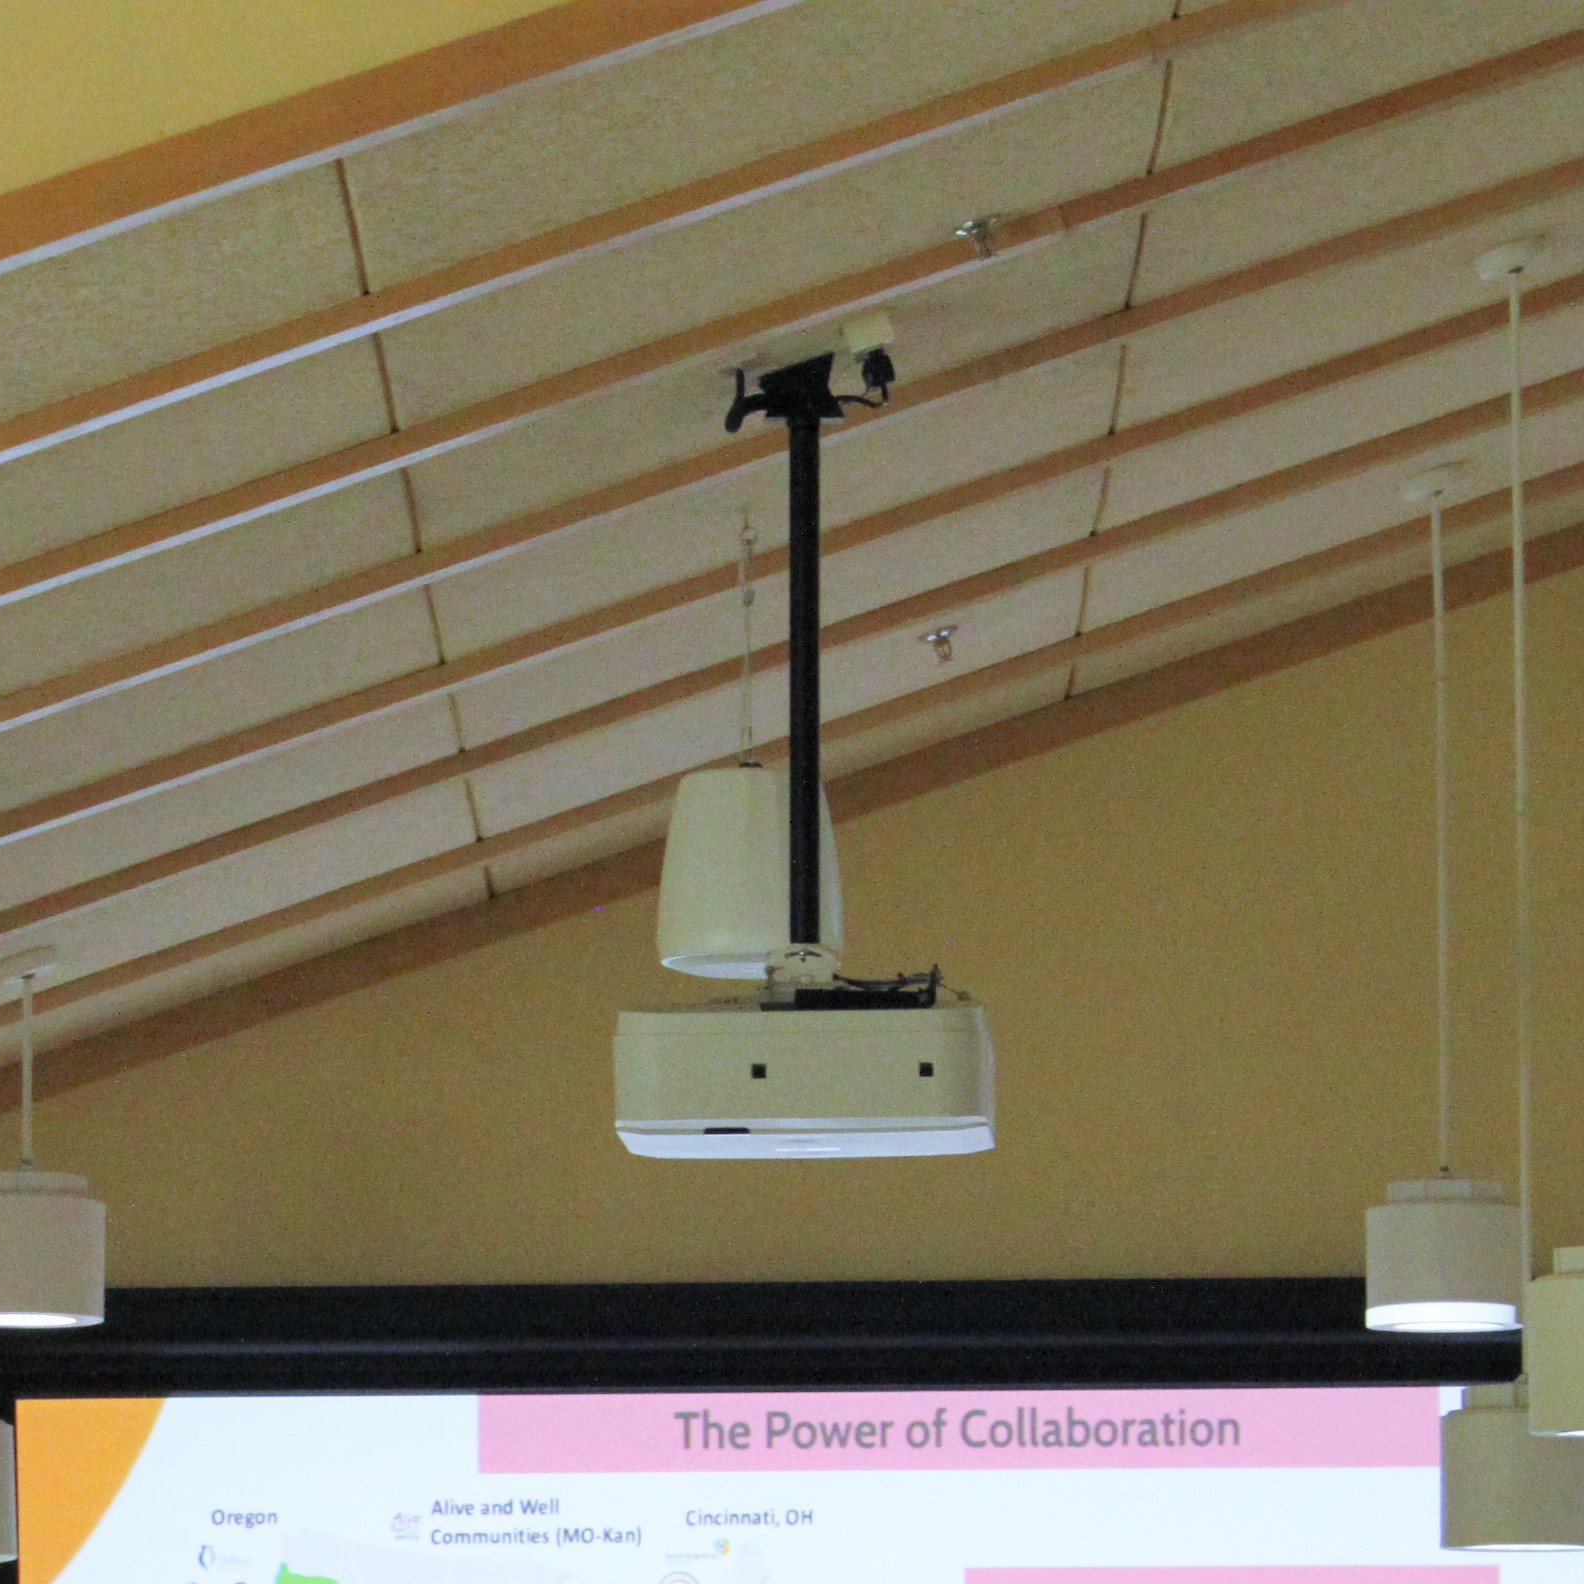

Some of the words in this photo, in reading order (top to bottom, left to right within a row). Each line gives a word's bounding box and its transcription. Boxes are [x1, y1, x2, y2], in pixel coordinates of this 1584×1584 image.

[673, 1408, 751, 1451] The
[765, 1409, 895, 1451] Power
[904, 1406, 948, 1450] of
[959, 1403, 1241, 1449] Collaboration
[431, 1498, 475, 1517] Alive
[479, 1498, 514, 1517] and
[519, 1497, 560, 1516] Well
[684, 1508, 780, 1528] Cincinnati,
[784, 1508, 815, 1527] OH
[210, 1508, 279, 1530] Oregon
[430, 1527, 551, 1546] Communities
[555, 1526, 643, 1548] (MO-Kan)
